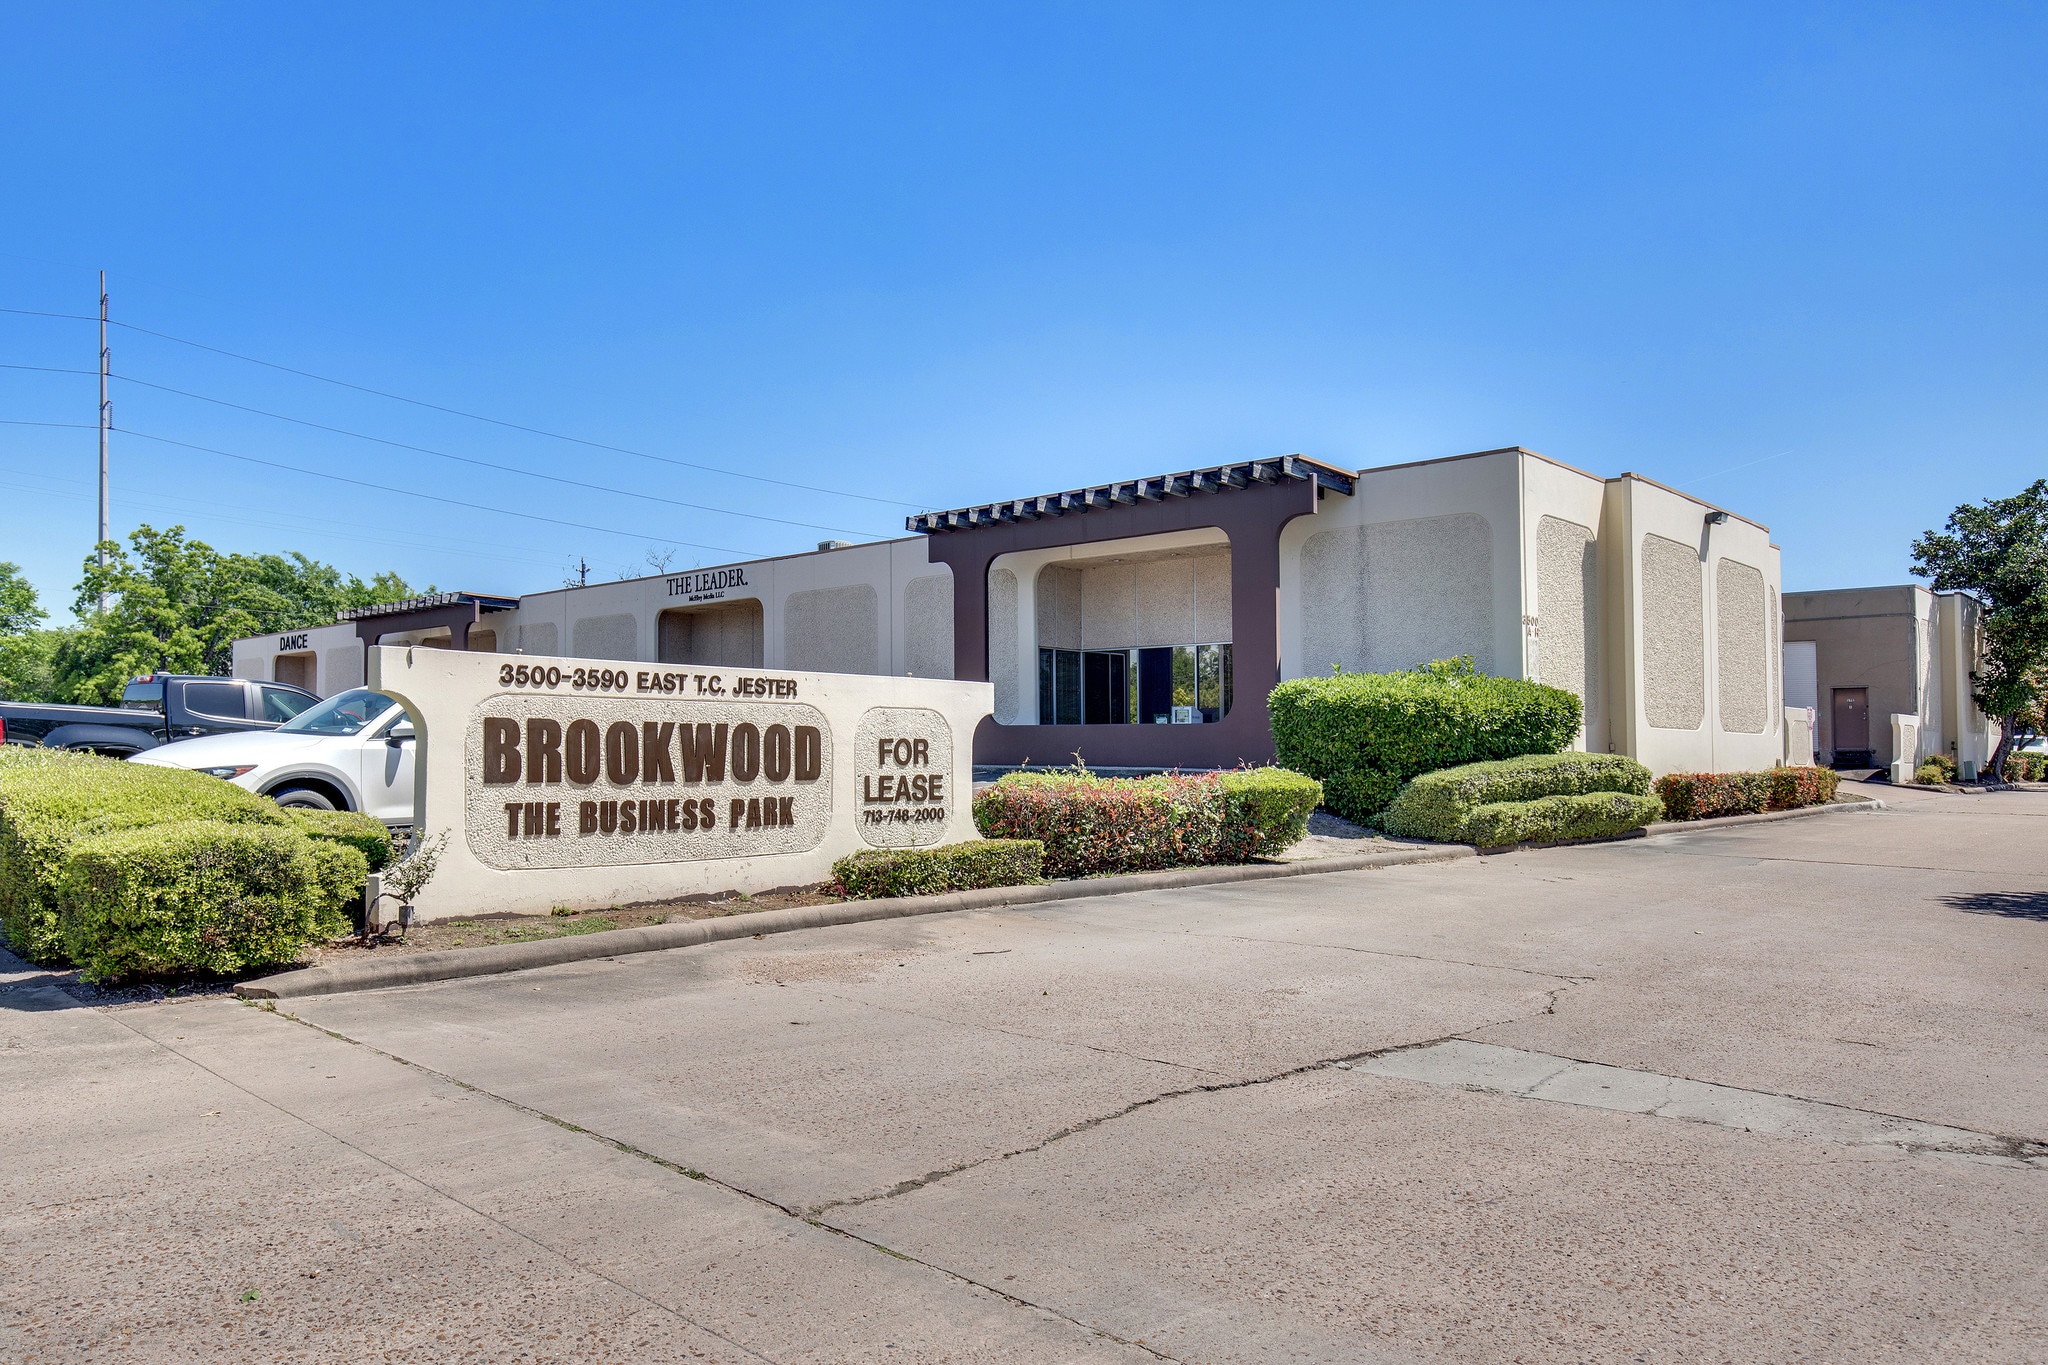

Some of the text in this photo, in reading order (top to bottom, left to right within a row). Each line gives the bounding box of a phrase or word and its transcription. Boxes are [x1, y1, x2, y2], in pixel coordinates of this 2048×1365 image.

[667, 576, 692, 596] THE
[716, 591, 725, 599] LLC
[280, 633, 308, 651] DANCE
[500, 664, 797, 696] 3500-3590 EAST T.C. JESTER
[484, 717, 822, 785] BROOKWOOD
[879, 738, 929, 766] FOR
[864, 774, 944, 803] LEASE
[505, 797, 795, 837] THE BUSINESS PARK
[863, 807, 945, 824] 713-748-2000
